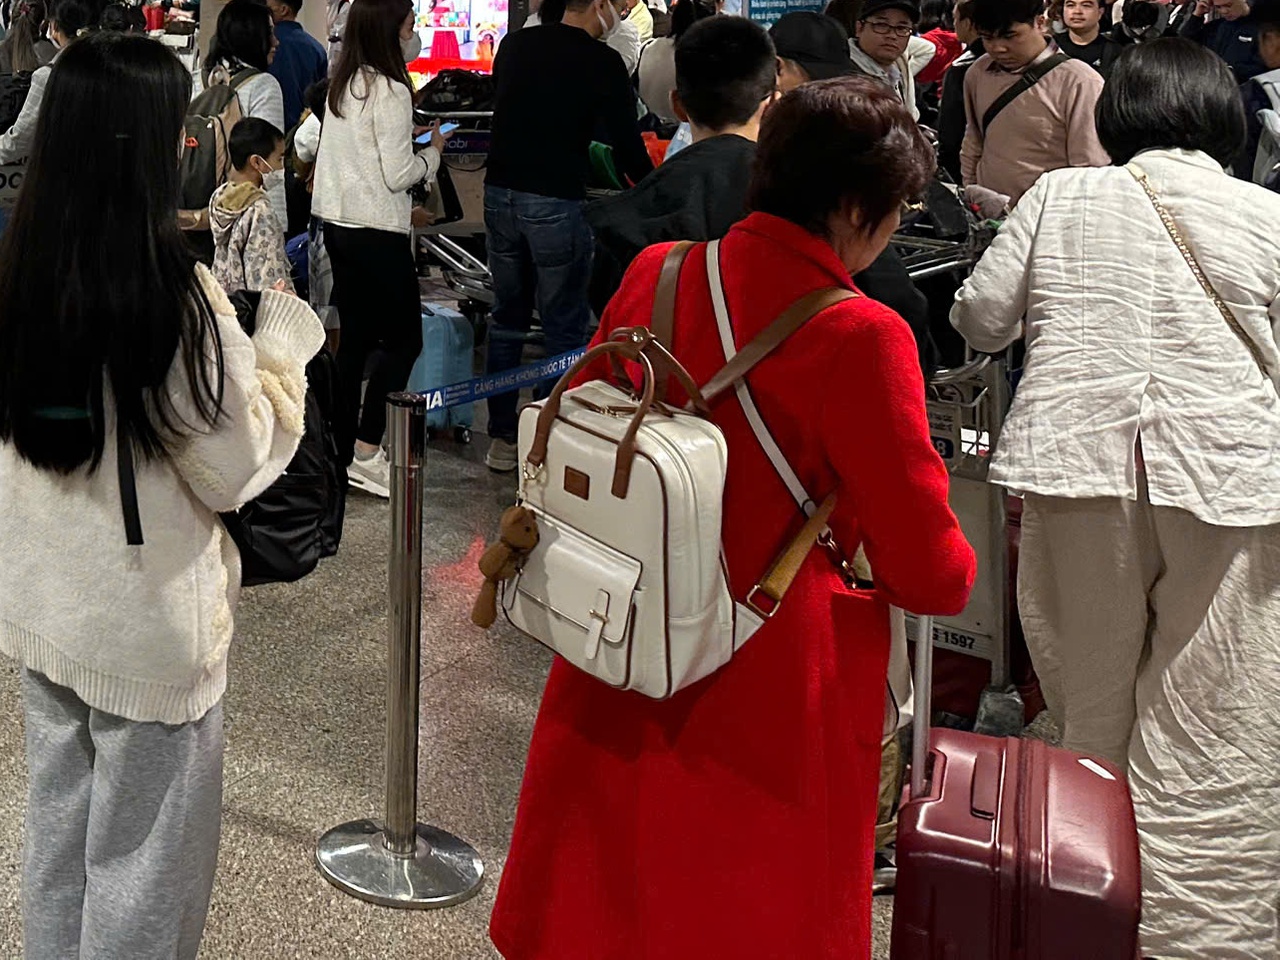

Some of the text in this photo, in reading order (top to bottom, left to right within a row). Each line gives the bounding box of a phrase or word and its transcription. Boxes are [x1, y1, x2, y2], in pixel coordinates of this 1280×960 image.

[558, 357, 567, 371] TẾ
[424, 391, 443, 410] IA
[944, 631, 975, 649] 1597
